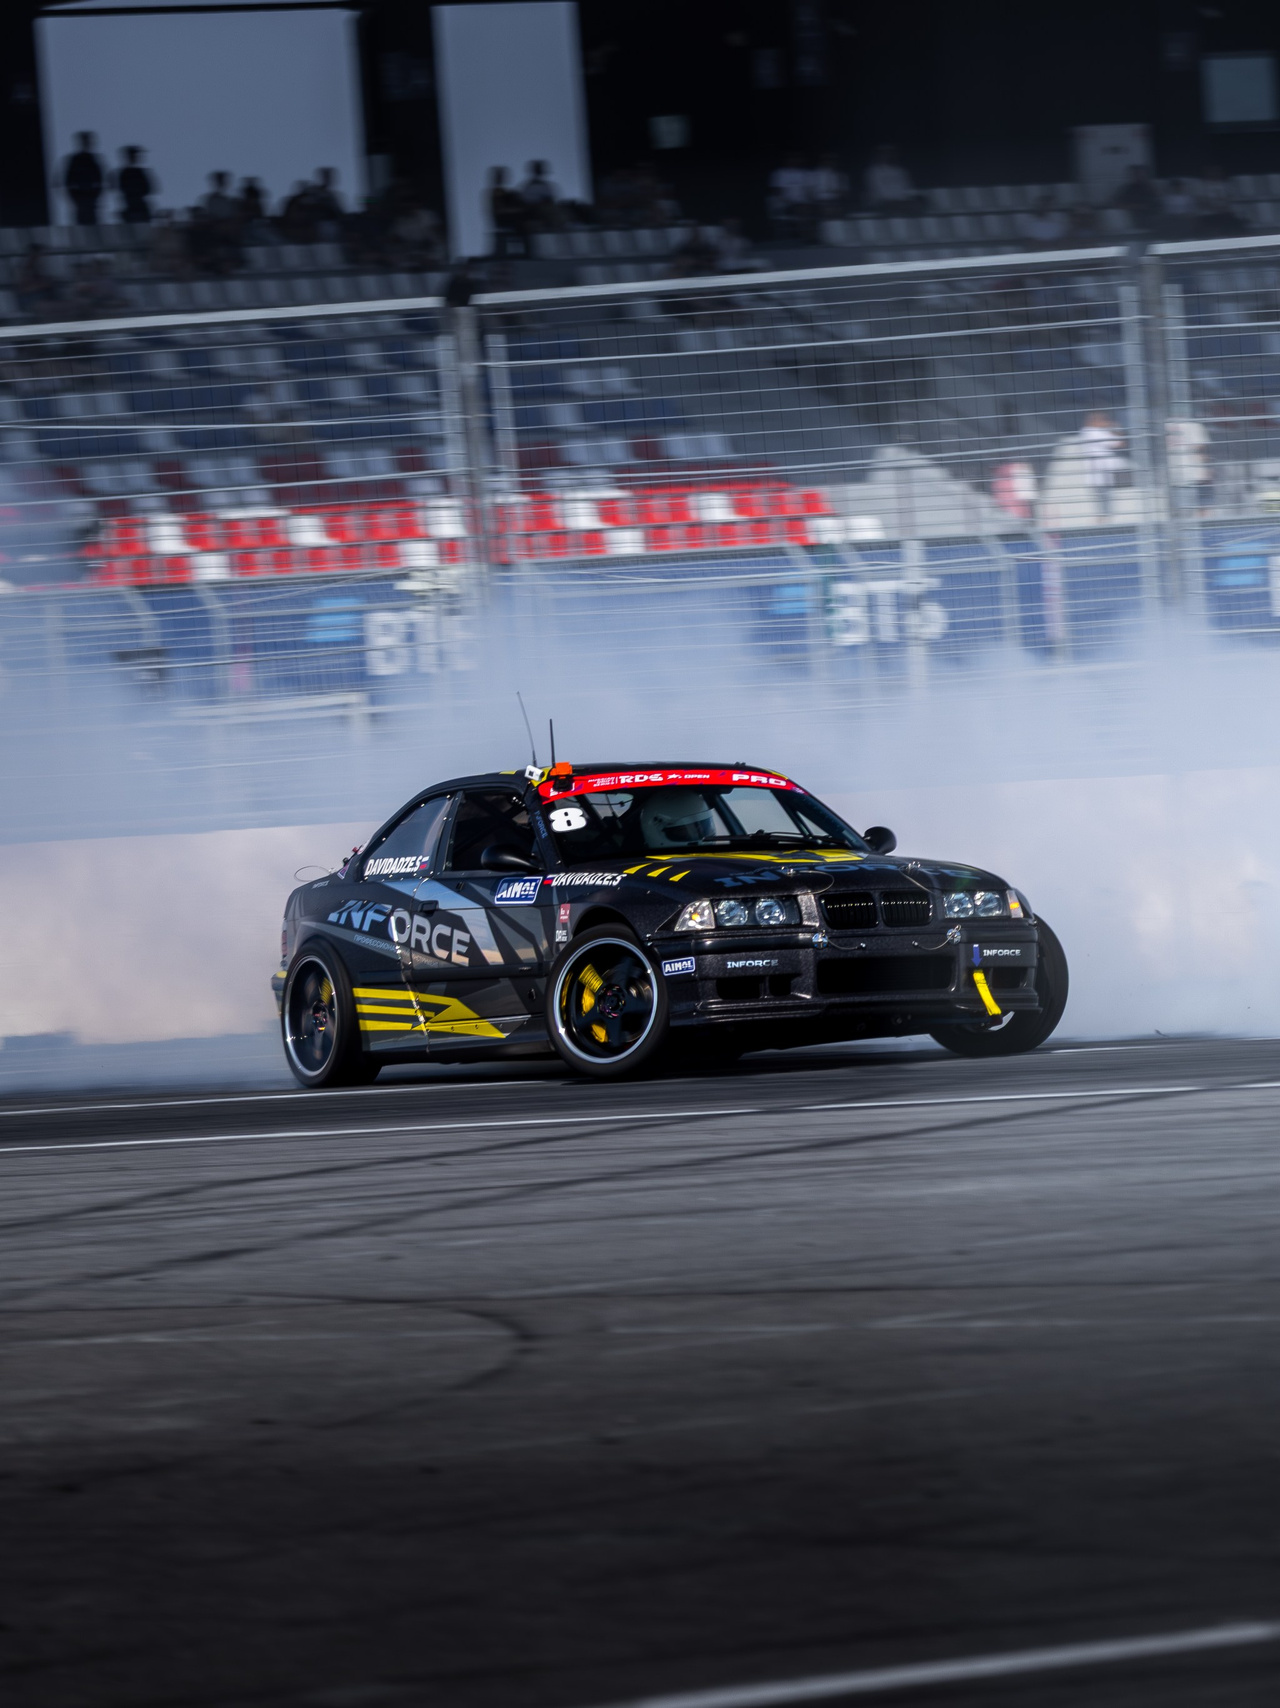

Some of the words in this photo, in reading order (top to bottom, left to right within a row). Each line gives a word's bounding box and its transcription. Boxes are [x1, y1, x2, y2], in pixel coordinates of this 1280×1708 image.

[732, 773, 787, 787] PRO
[549, 807, 587, 832] 8
[497, 881, 536, 899] AIMOL
[327, 899, 471, 967] INFORCE
[983, 949, 1021, 957] INFORCE
[664, 961, 694, 974] AIMOL
[727, 959, 779, 969] INFORCE
